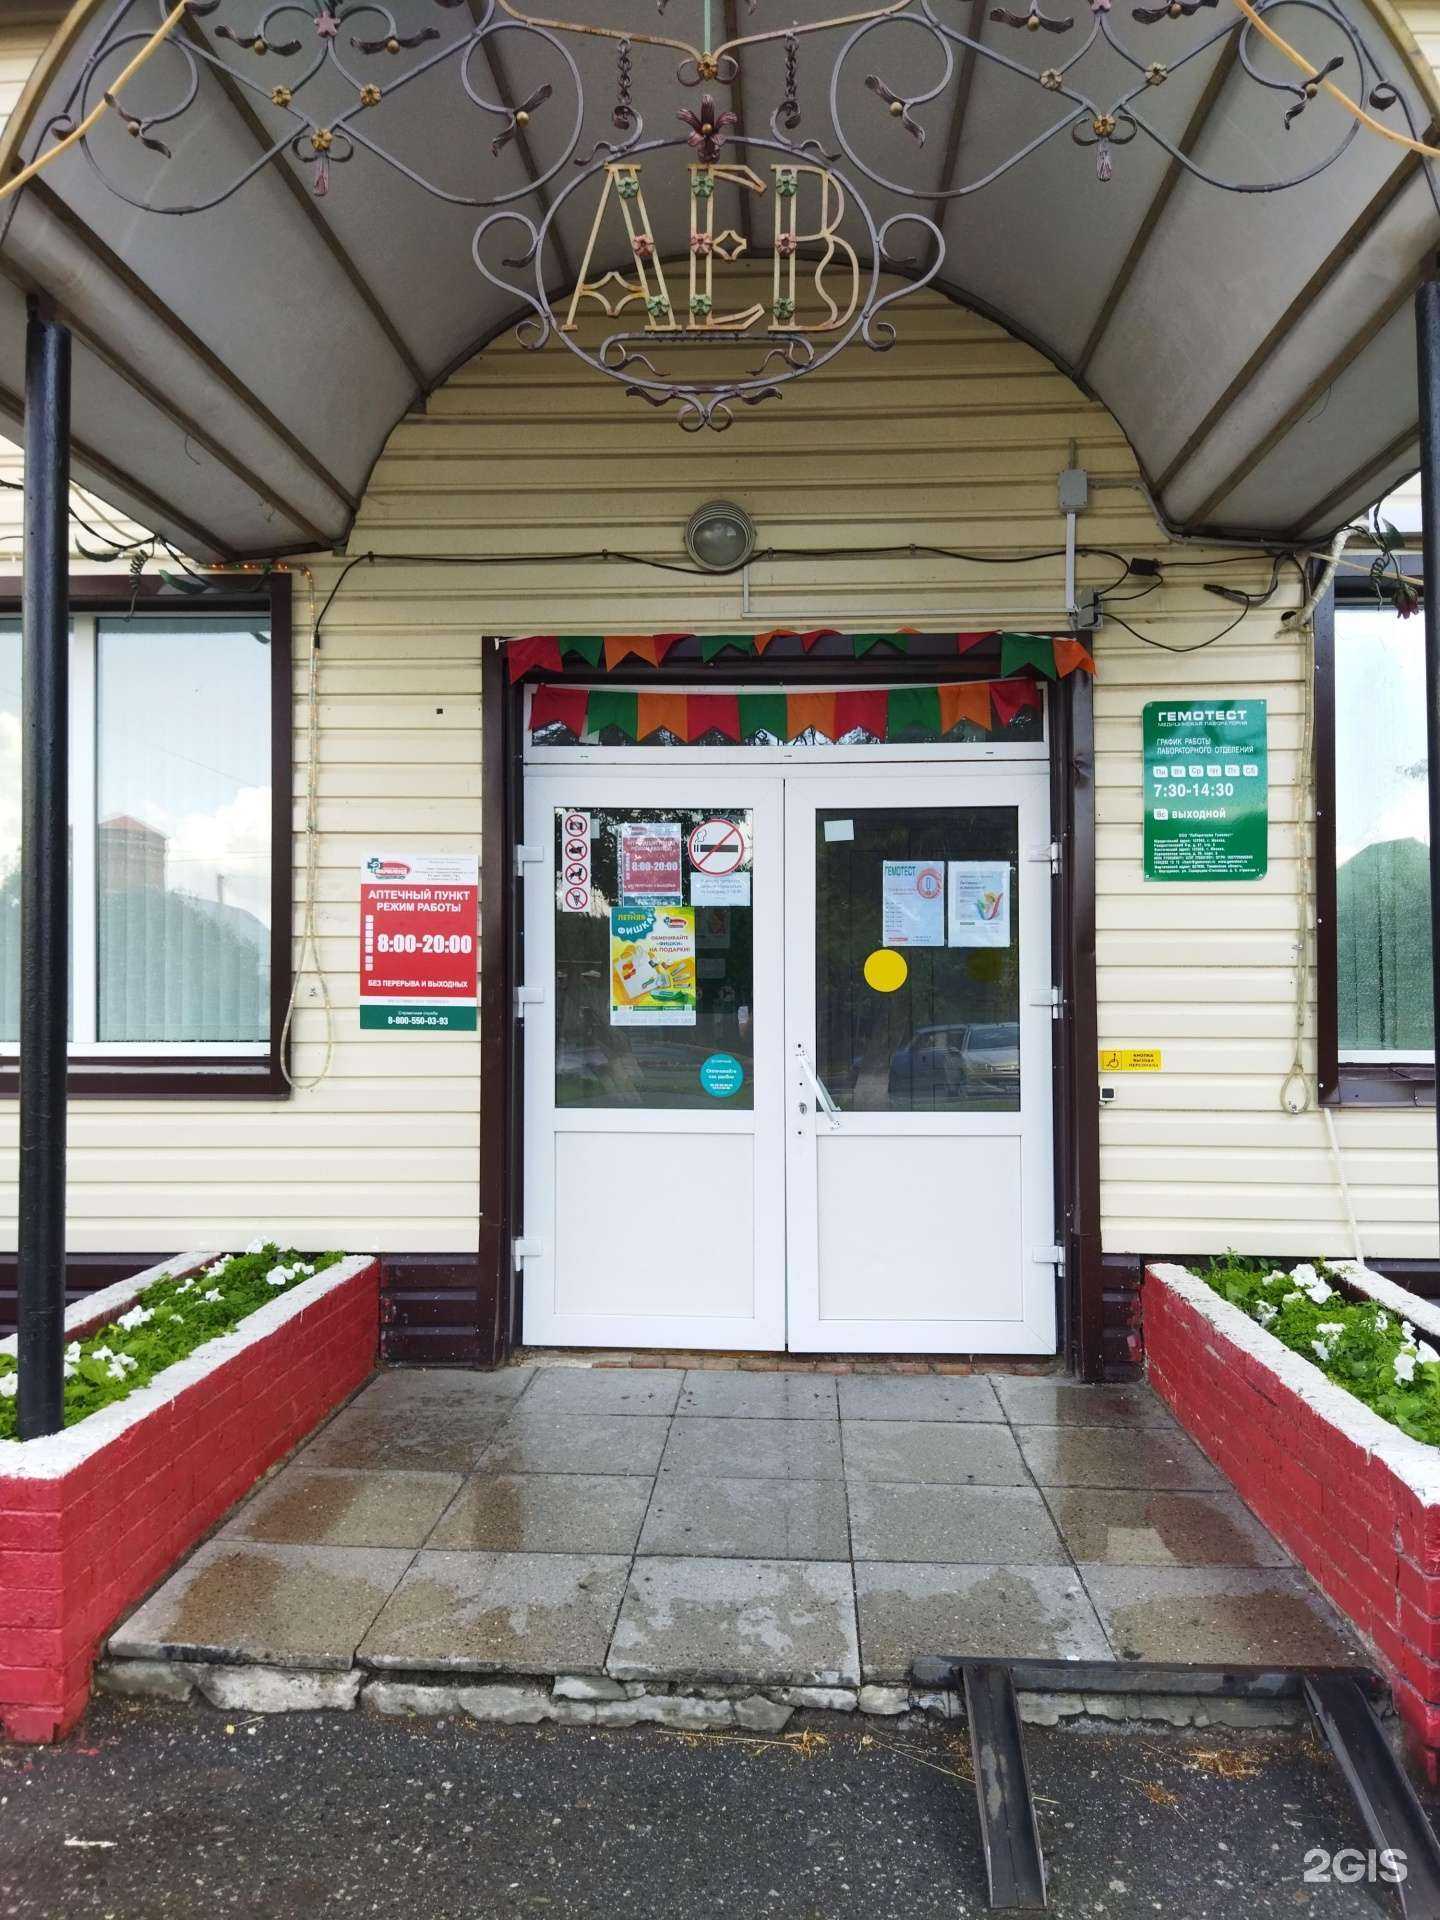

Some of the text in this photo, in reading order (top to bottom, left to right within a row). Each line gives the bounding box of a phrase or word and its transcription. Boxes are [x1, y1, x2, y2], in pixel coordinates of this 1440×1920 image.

[1158, 710, 1248, 722] ГЕМОТЕСТ
[1157, 737, 1211, 746] ГРАФИК РАБОТЫ
[1157, 746, 1212, 755] ЛАБОРАТОРНОГО
[1153, 783, 1234, 798] 7:30-14:30
[885, 866, 916, 877] ГЕМОТЕСТ
[368, 888, 470, 901] АПТЕЧНЫЙ ПУНКТ
[376, 902, 461, 912] РЕЖИМ РАБОТЫ
[377, 934, 472, 954] 8:00-20:00
[368, 979, 468, 989] БЕЗ ПЕРЕРЫВА И ВЫХОДНЫХ
